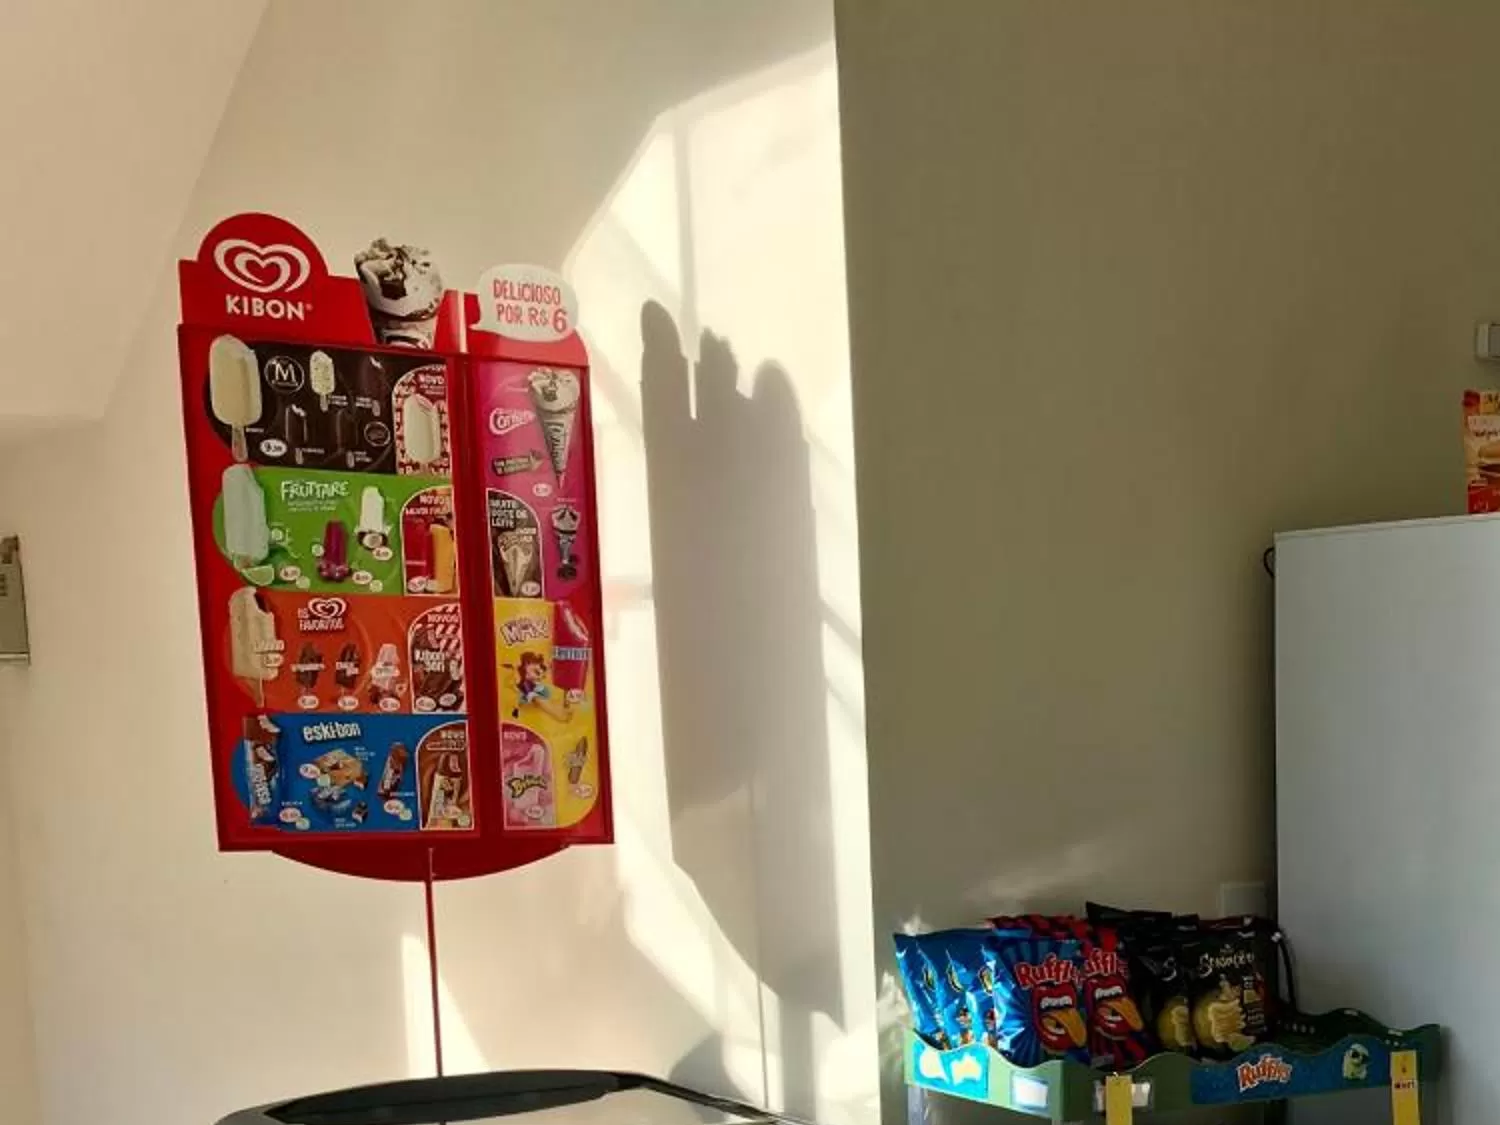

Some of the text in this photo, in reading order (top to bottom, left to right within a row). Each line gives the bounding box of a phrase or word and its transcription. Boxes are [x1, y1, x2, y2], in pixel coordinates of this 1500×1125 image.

[492, 278, 562, 306] DELICIOSO
[225, 293, 306, 321] KIBON
[496, 302, 523, 325] POR
[552, 307, 568, 334] 6
[281, 481, 350, 502] FRUTTARE
[1236, 1053, 1294, 1093] Ruffles
